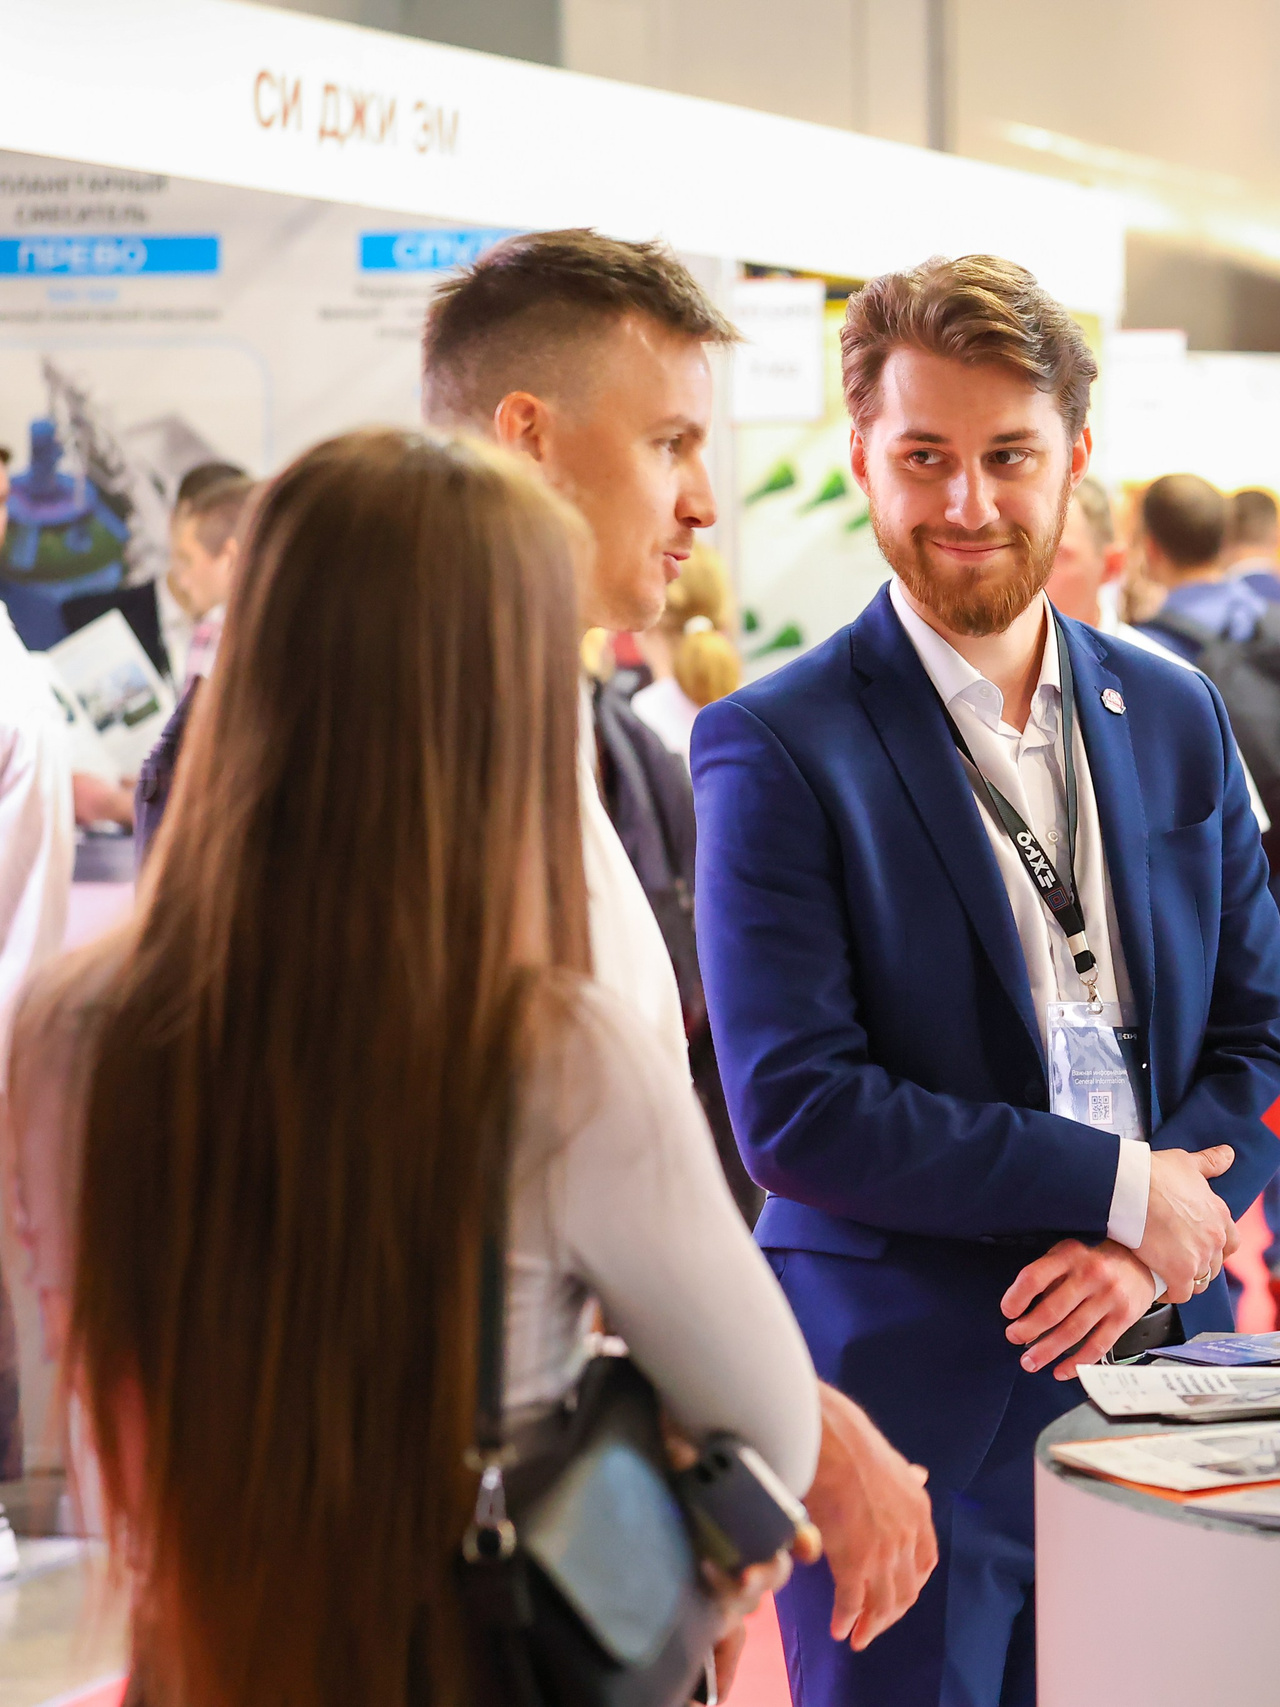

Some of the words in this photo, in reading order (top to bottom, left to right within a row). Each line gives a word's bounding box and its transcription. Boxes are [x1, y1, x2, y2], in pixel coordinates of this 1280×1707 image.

[253, 68, 303, 131] СИ
[317, 82, 398, 145] ДЖИ
[413, 100, 460, 154] ЭМ
[1016, 829, 1056, 889] EXPO
[1074, 1077, 1094, 1085] General
